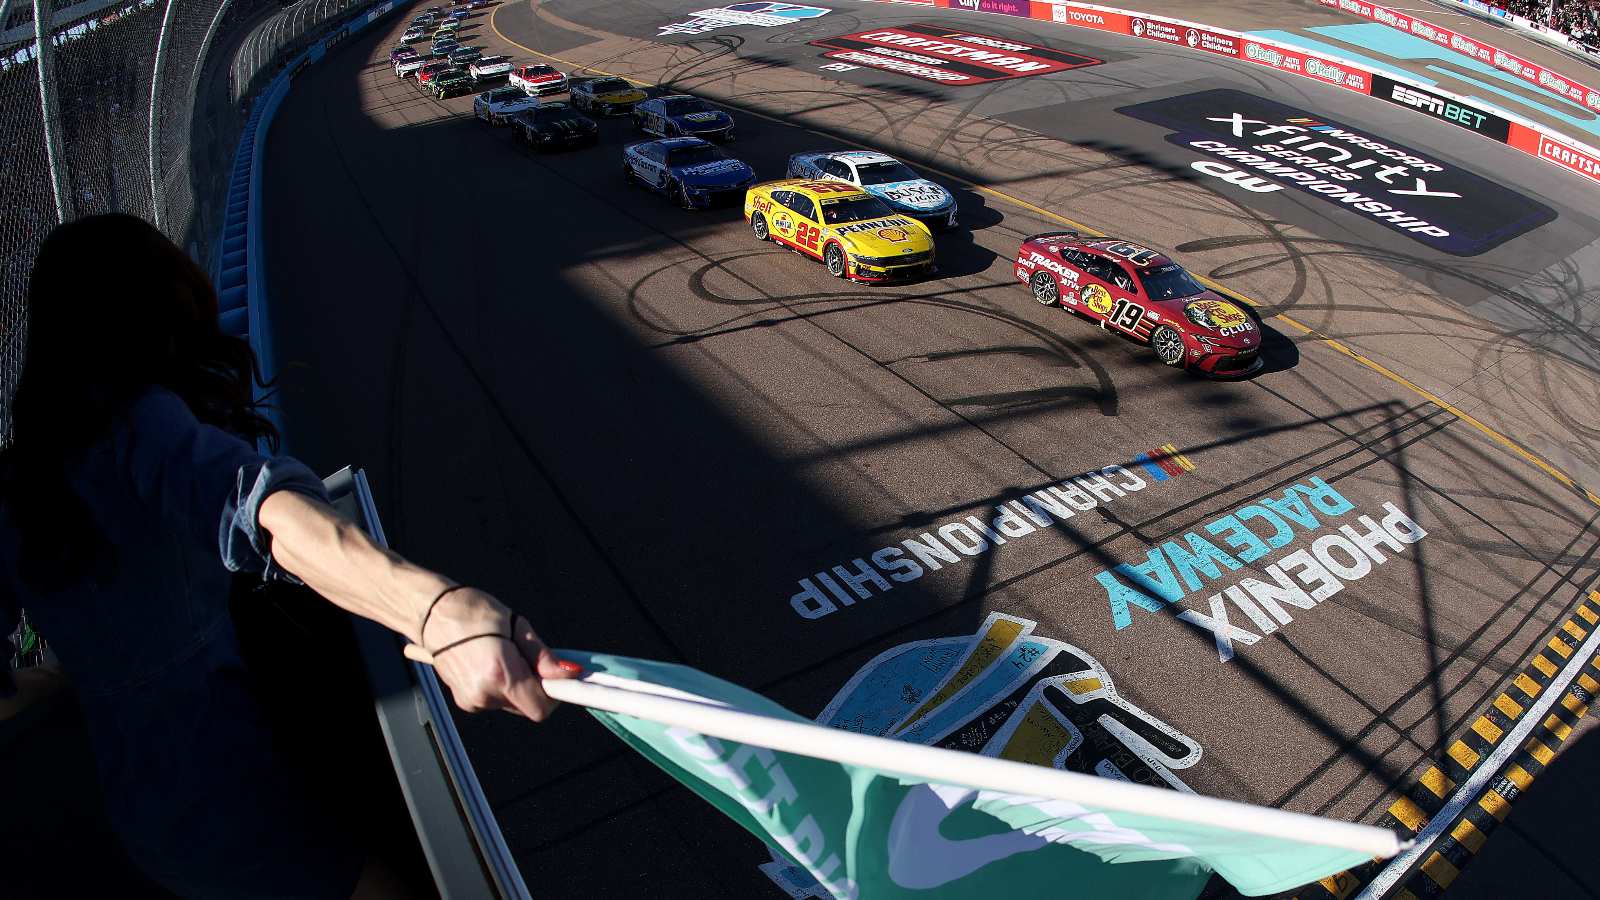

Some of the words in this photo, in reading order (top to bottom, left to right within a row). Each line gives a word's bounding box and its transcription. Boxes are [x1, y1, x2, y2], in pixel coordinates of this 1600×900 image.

[1068, 10, 1104, 25] TOYOTA
[1147, 22, 1175, 34] Shriners
[1146, 29, 1181, 42] Children's
[1201, 33, 1233, 46] Shriners
[1201, 41, 1239, 54] Children's
[859, 32, 1050, 72] CRAFTSMAN
[1345, 78, 1364, 90] PARTS
[1347, 73, 1363, 83] AUTO
[1391, 85, 1444, 115] ESPN
[1444, 103, 1487, 129] BET
[1319, 124, 1445, 173] NASCAR
[1252, 143, 1363, 182] SERIES
[908, 194, 941, 203] LIGHT
[1189, 139, 1450, 239] CHAMPIONSHIP
[753, 195, 772, 214] Shell
[795, 221, 821, 251] 22
[835, 217, 915, 236] PENNZOIL
[1029, 251, 1080, 282] TRACKER
[1109, 298, 1145, 332] 19
[1220, 322, 1253, 337] CLUB
[790, 464, 1148, 621] CHAMPIONSHIP
[1094, 475, 1356, 631] RACEWAY
[1176, 500, 1429, 663] PHOENIX
